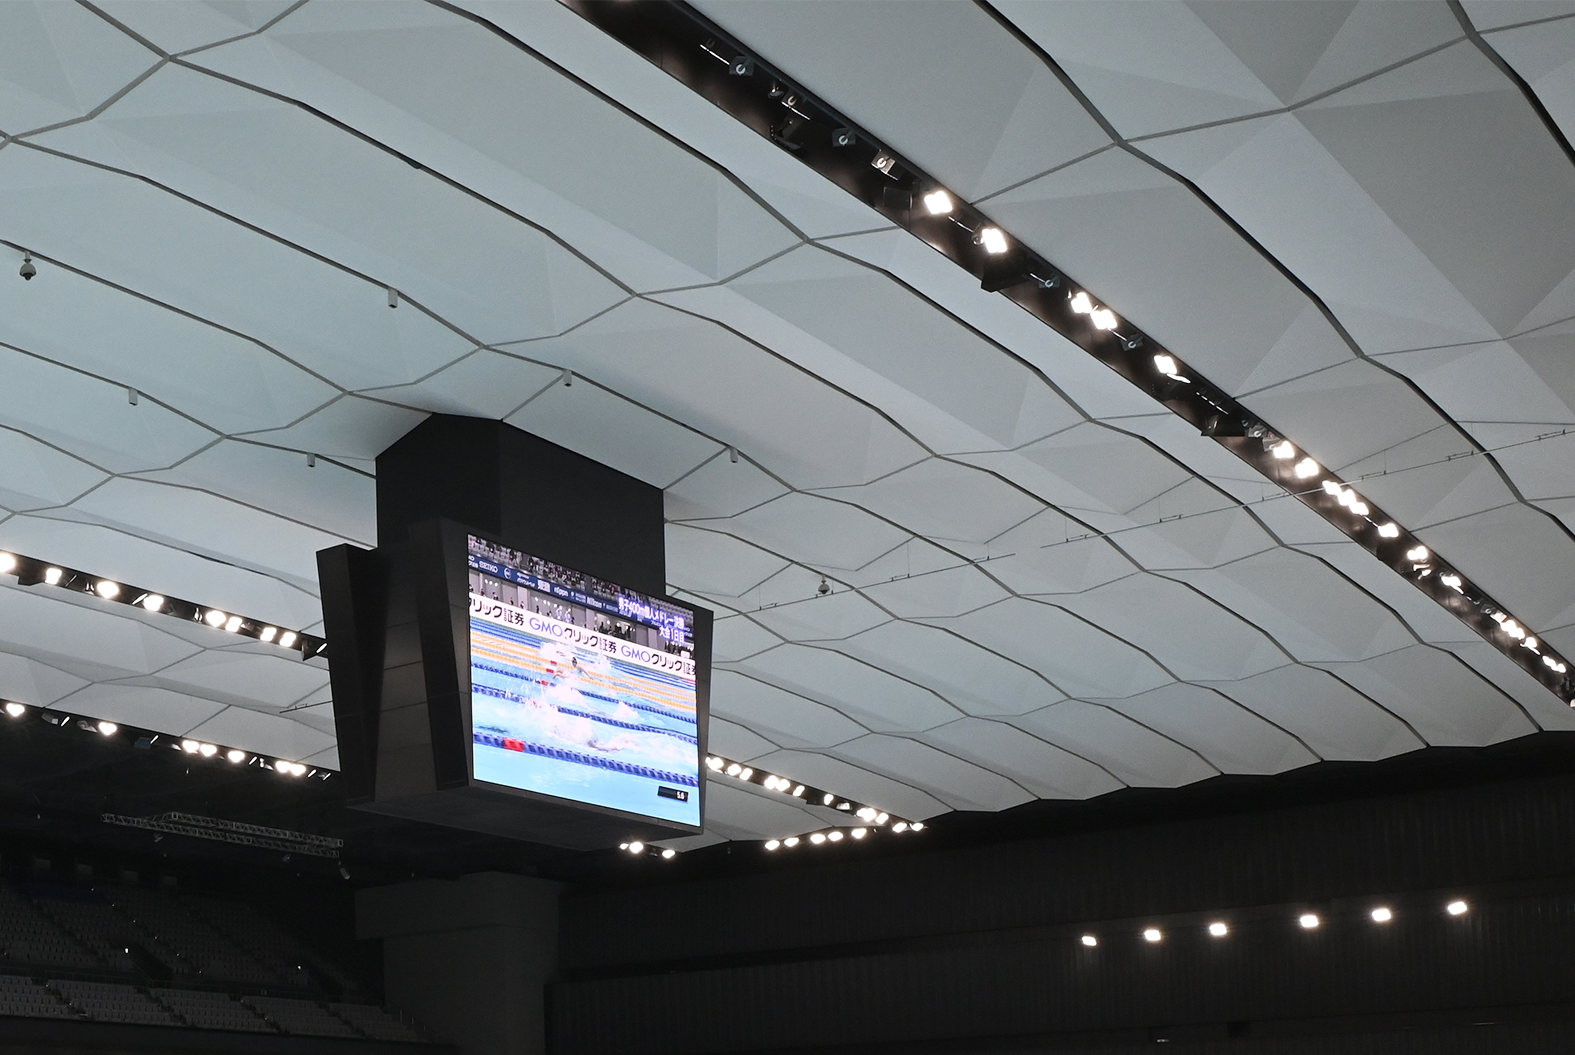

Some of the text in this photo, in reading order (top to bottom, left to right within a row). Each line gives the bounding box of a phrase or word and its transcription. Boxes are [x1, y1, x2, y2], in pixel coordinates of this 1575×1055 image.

[479, 560, 499, 573] SEIKO
[529, 617, 563, 638] GMO
[621, 645, 651, 663] GMO
